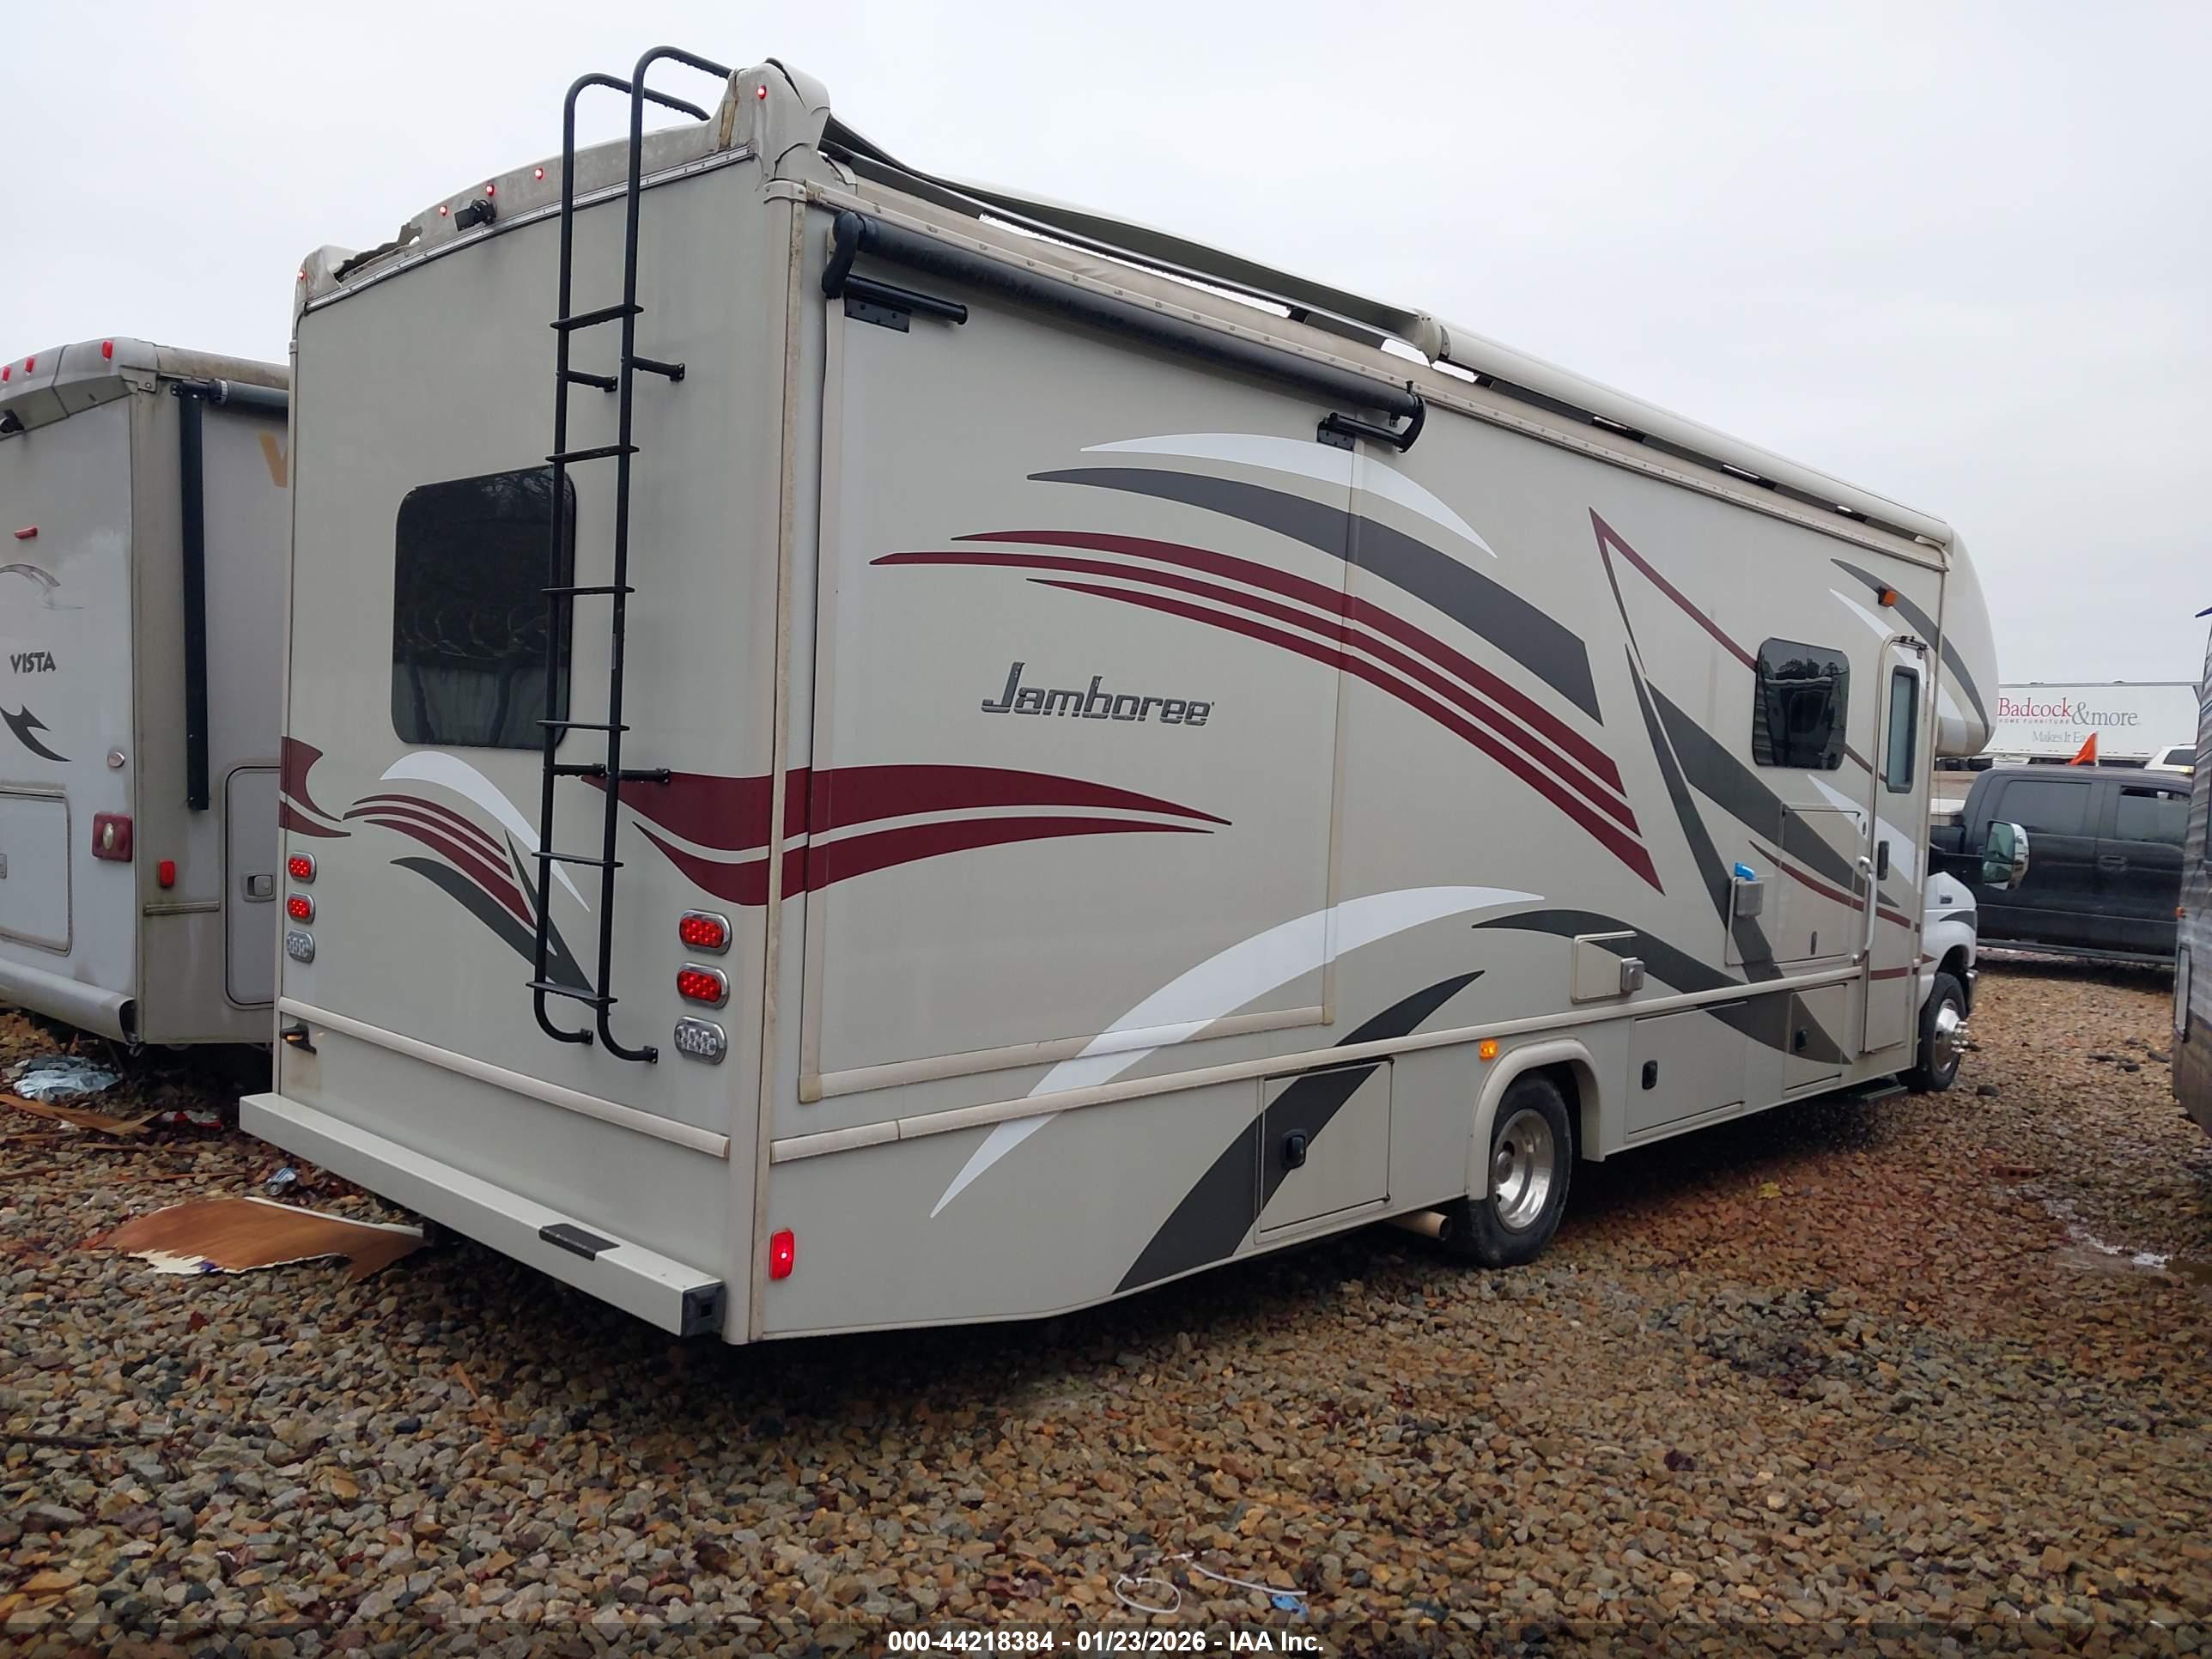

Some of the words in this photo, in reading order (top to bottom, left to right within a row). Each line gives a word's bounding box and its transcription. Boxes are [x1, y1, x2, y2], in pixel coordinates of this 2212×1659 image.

[9, 651, 56, 674] VISTA
[981, 661, 1212, 726] Jamboree
[2033, 731, 2062, 743] Makes
[2063, 731, 2070, 743] It
